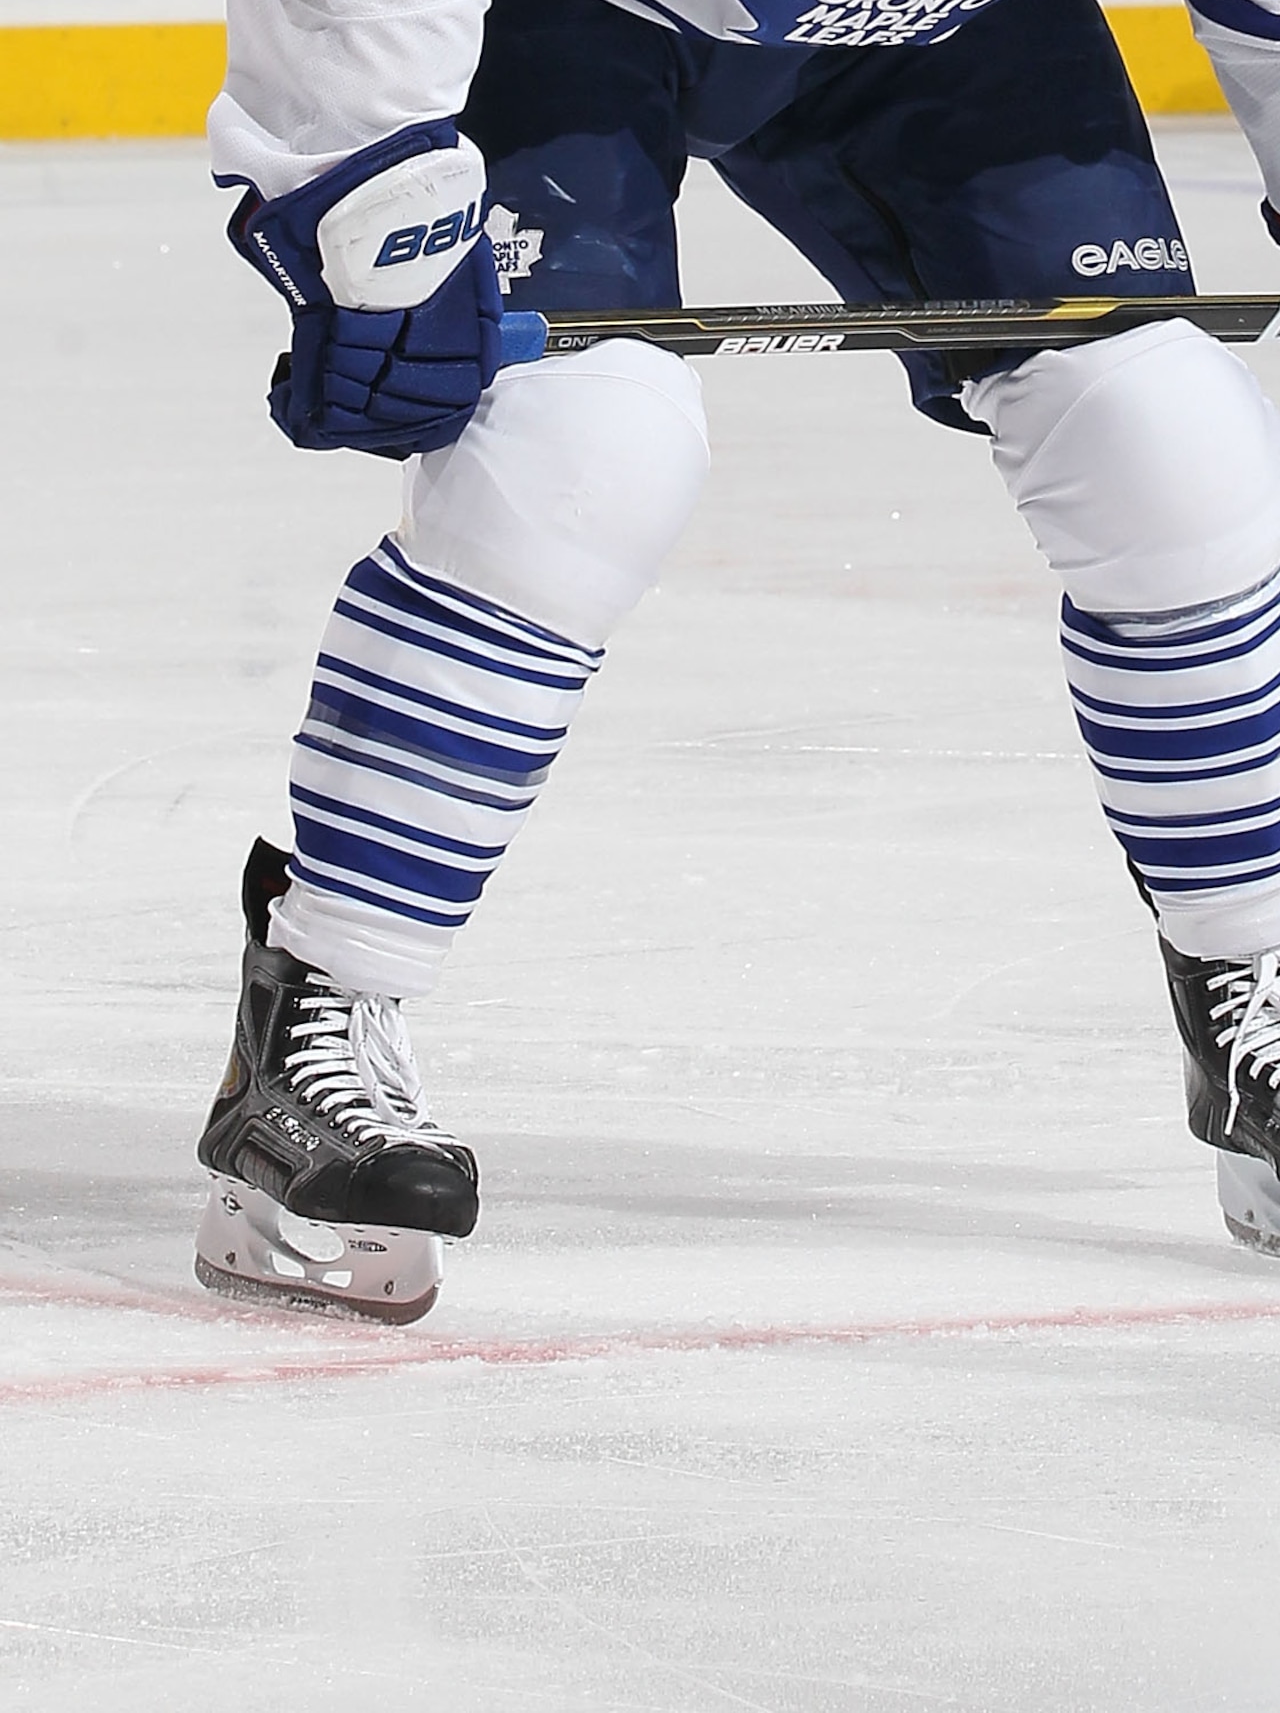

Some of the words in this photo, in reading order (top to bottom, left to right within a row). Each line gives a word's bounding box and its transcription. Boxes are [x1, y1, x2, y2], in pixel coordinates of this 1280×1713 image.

[796, 4, 950, 31] MAPLE
[783, 23, 917, 46] LEAFS
[253, 231, 307, 306] MACARTHUR
